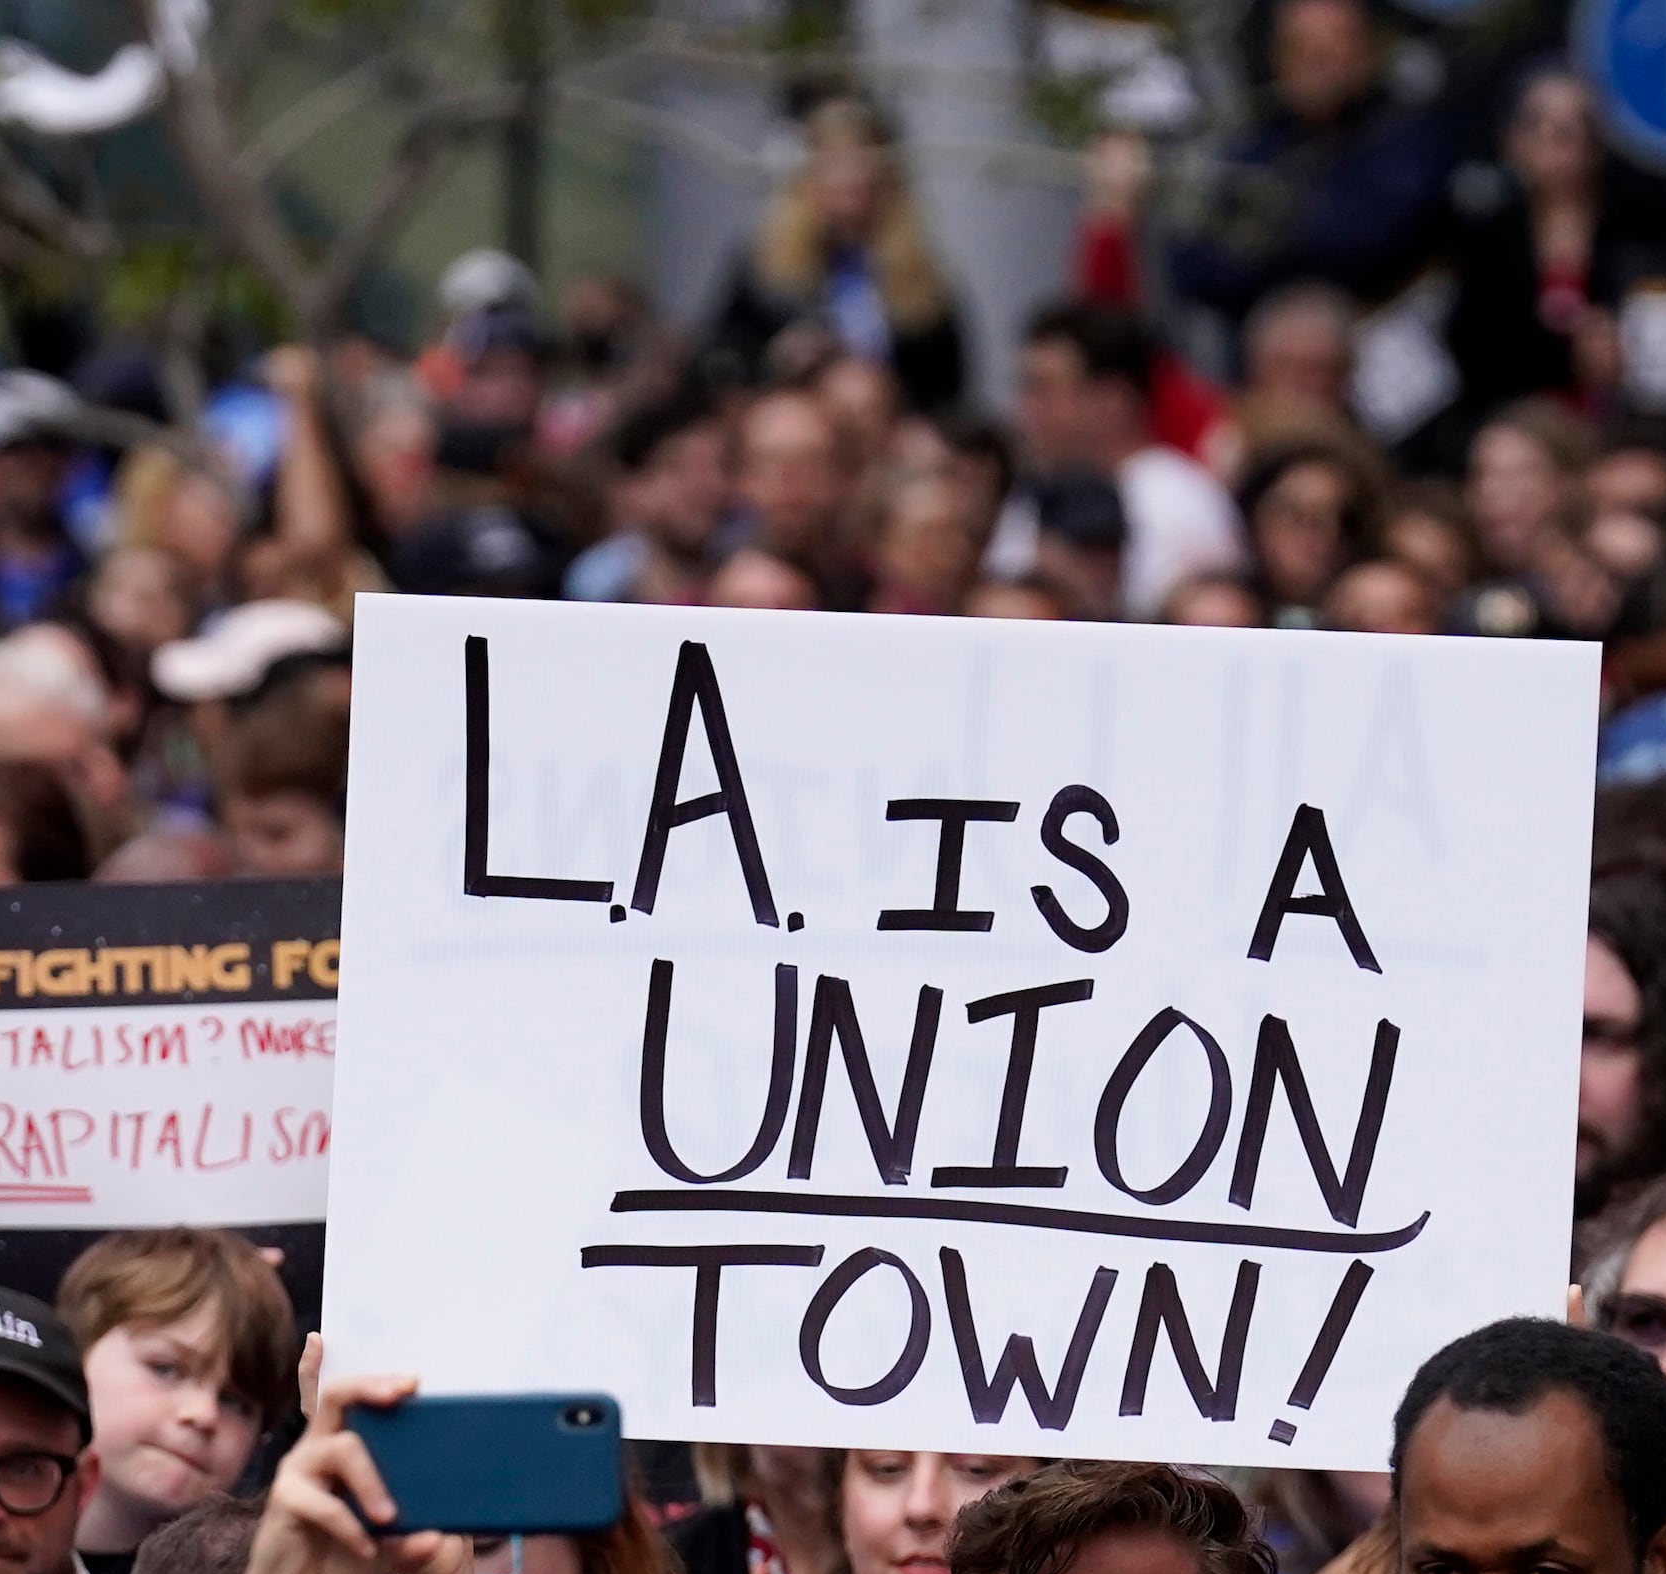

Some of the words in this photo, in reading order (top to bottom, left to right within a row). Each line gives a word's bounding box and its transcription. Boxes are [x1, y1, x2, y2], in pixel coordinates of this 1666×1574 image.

[464, 634, 805, 932] L.A.
[876, 784, 1130, 954] IS
[1246, 803, 1383, 975] A
[640, 958, 1401, 1229] UNION
[580, 1244, 1375, 1447] TOWN!
